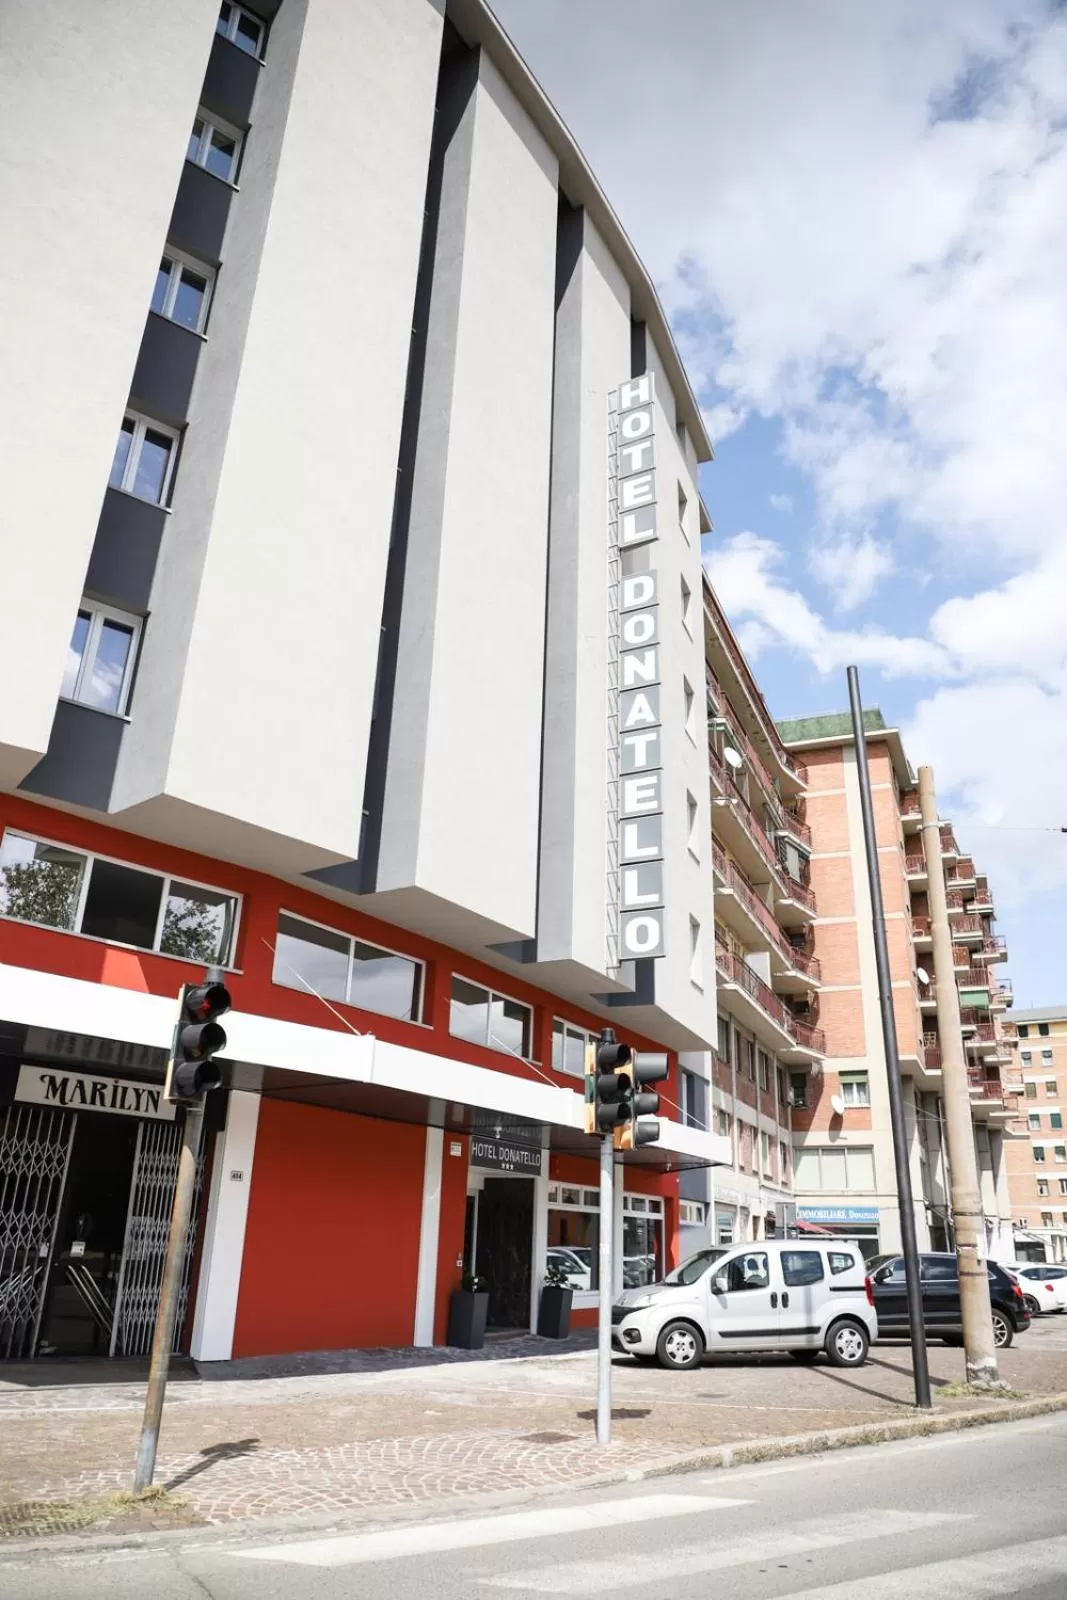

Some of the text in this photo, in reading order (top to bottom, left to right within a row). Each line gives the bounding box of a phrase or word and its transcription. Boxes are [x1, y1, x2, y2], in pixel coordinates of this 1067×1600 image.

[621, 377, 660, 954] HOTEL DONATELLO
[471, 1141, 497, 1159] HOTEL
[499, 1147, 540, 1166] DONATELLO
